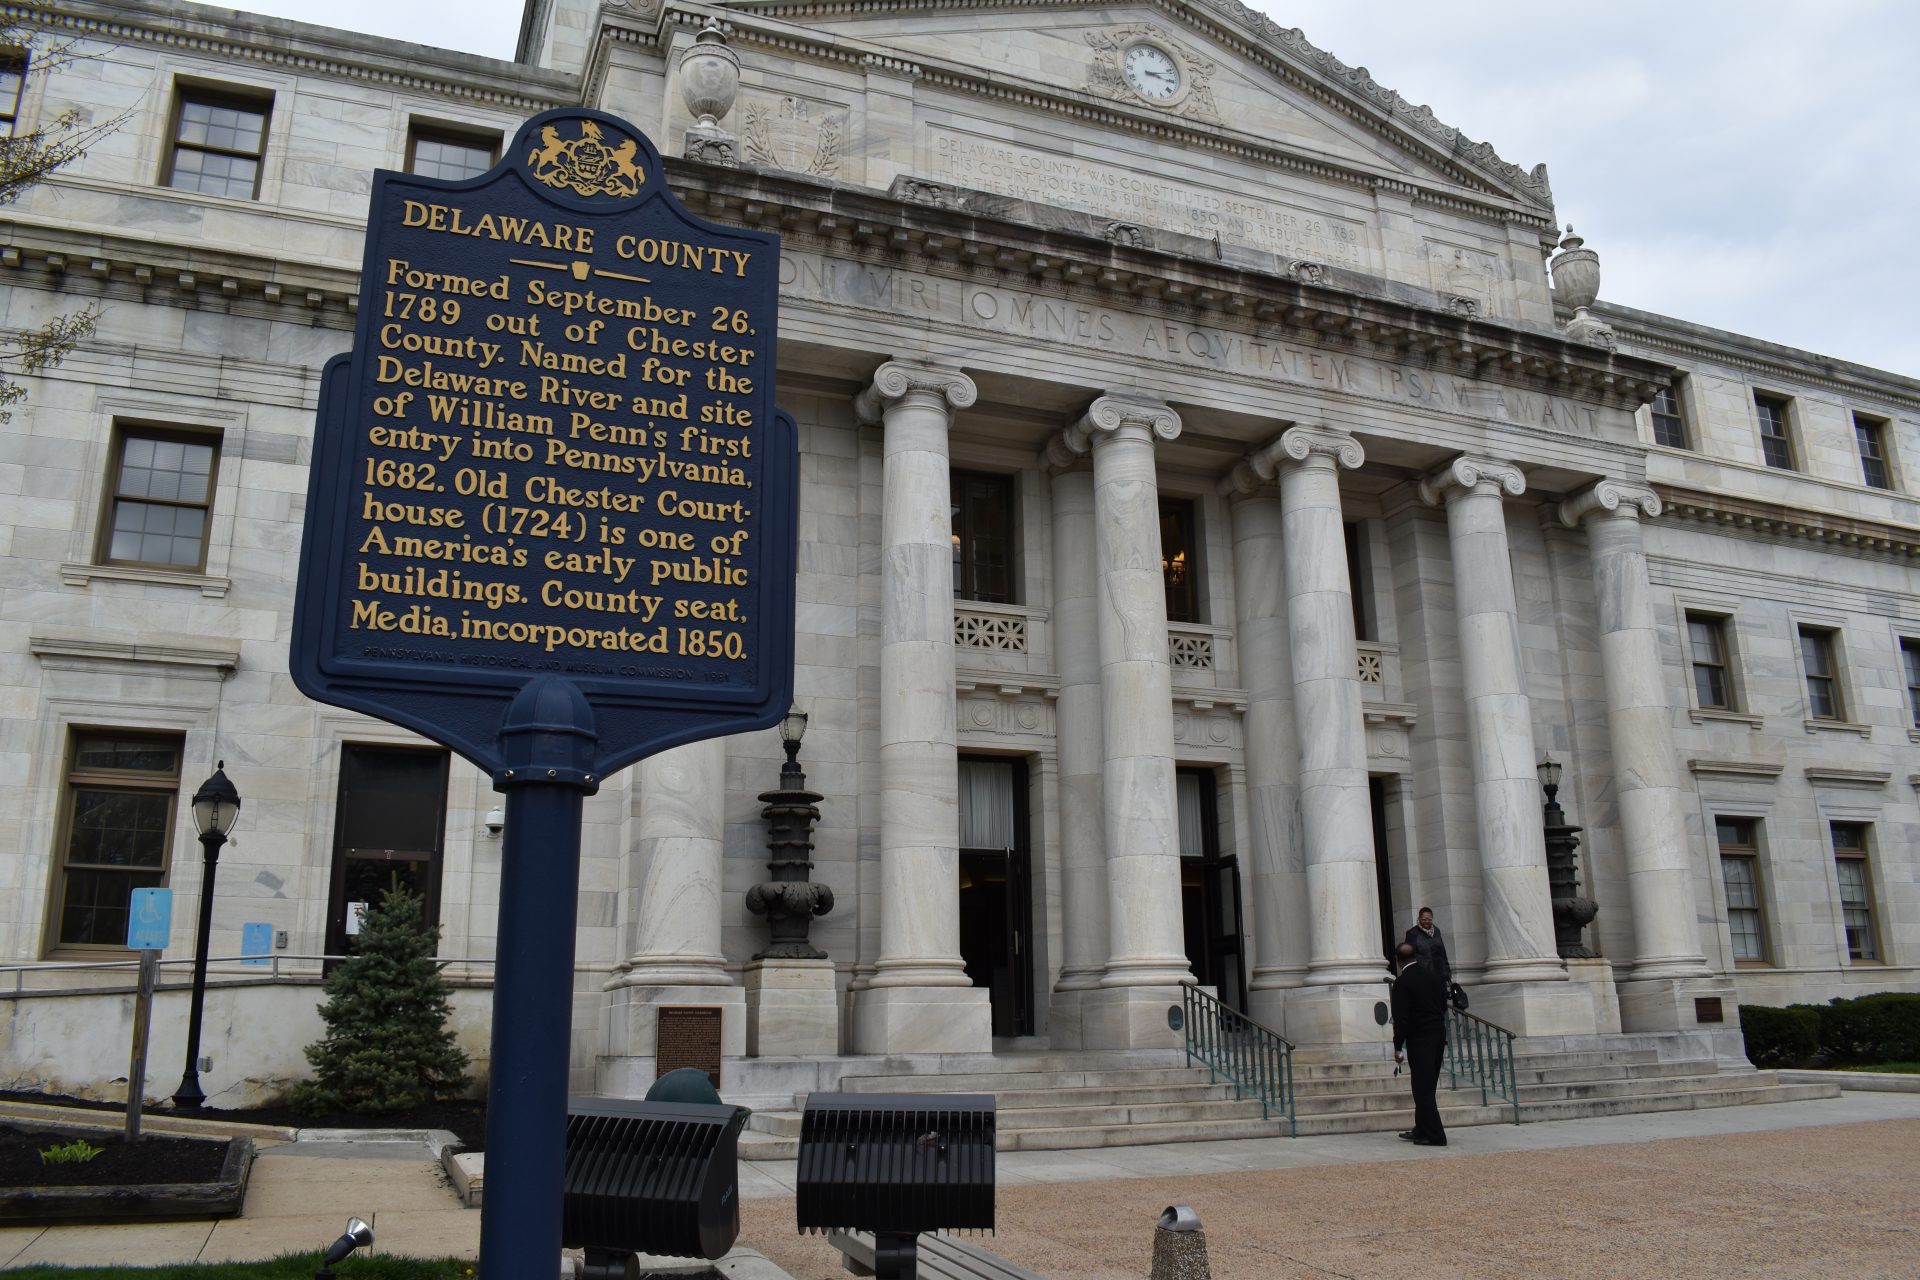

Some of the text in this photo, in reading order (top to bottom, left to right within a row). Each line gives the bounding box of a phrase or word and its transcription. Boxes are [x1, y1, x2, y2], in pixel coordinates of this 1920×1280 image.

[938, 137, 1015, 164] DELAWARE
[1019, 155, 1081, 178] COUNTY
[1087, 169, 1115, 187] WAS
[1119, 176, 1221, 210] CONSTITUTED
[1225, 201, 1297, 227] SEPTEMBER
[1304, 219, 1321, 233] 26
[939, 153, 972, 172] THIS
[978, 162, 1033, 183] COURT
[1038, 175, 1088, 196] HOUSE
[1089, 183, 1119, 203] WAS
[1123, 193, 1159, 210] BUILT
[1165, 202, 1181, 216] IN
[1184, 205, 1220, 226] 1850
[1227, 216, 1254, 233] AND
[1259, 224, 1314, 248] REBUILT
[973, 176, 1003, 194] THE
[1007, 184, 1051, 202] SIXTH
[1117, 207, 1178, 232] JUDICIAL
[402, 200, 749, 277] DELAWARE COUNTY
[383, 290, 755, 366] 1789 out of Chester
[387, 258, 756, 336] Formed September 26,
[380, 323, 753, 395] County. Named for the
[866, 271, 943, 312] VIRI
[970, 290, 1116, 343] OMNES
[1141, 322, 1351, 388] AEQVITATEM
[1376, 365, 1472, 409] IPSAM
[1494, 388, 1597, 434] AMANT
[373, 391, 752, 458] of William Penn's first
[377, 355, 753, 427] Delaware River and site
[364, 457, 751, 524] 1682. Old Chester Court-
[368, 426, 752, 488] entry into Pennsylvania,
[359, 526, 748, 586] America's early public
[362, 491, 749, 556] house (1724) is one of
[357, 562, 747, 624] buildings. County seat,
[351, 599, 748, 660] Media, incorporated 1850.
[362, 646, 455, 664] PENNSYLVANIA
[459, 654, 533, 669] HISTORICAL
[535, 659, 562, 672] AND
[565, 663, 614, 675] MUSEUM
[619, 665, 694, 681] COMMISSION
